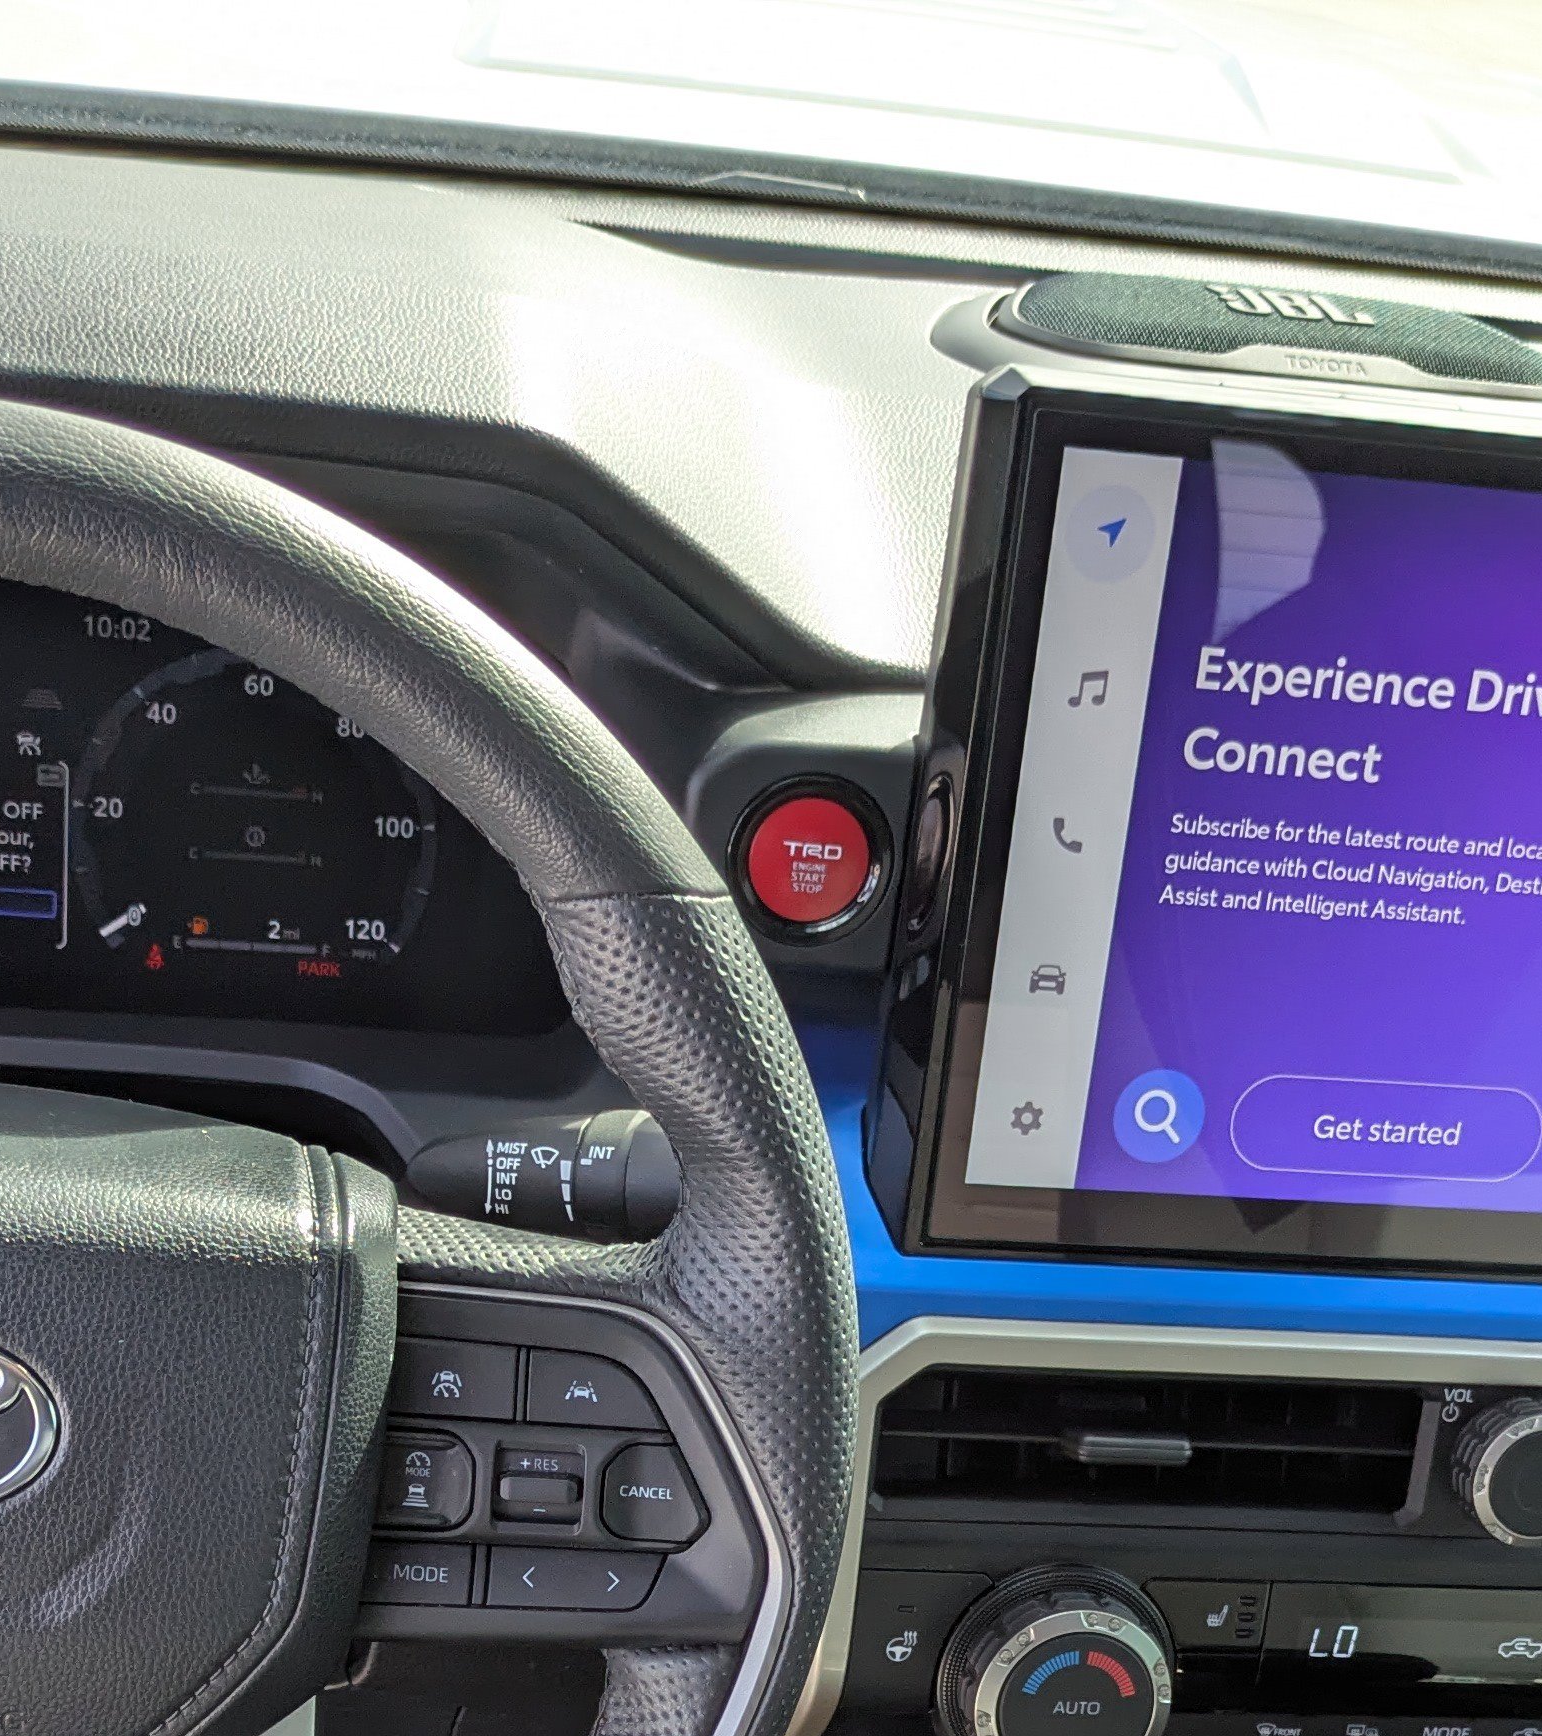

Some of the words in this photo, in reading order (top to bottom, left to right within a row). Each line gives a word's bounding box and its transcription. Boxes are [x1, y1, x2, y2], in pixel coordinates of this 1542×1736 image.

[1209, 284, 1374, 329] JBL
[1284, 353, 1368, 378] TOYOTA
[83, 614, 153, 643] 10:02
[244, 675, 275, 698] 60
[1195, 645, 1456, 711] Experience
[145, 703, 178, 727] 40
[337, 716, 367, 740] 80
[1183, 726, 1383, 784] Connect
[3, 802, 44, 821] OFF
[92, 797, 124, 820] 20
[374, 816, 414, 839] 100
[1170, 814, 1270, 840] Subscribe
[1274, 820, 1304, 844] for
[1306, 824, 1341, 847] the
[1344, 826, 1402, 851] latest
[1405, 834, 1459, 855] route
[1463, 835, 1502, 858] and
[783, 840, 843, 861] TRD
[791, 872, 826, 884] START
[1164, 852, 1260, 881] guidance
[1264, 857, 1308, 880] with
[1312, 860, 1373, 884] Cloud
[1377, 865, 1491, 896] Navigation,
[792, 882, 823, 894] STOP
[1158, 885, 1219, 909] Assist
[1221, 889, 1261, 911] and
[1265, 893, 1369, 920] Intelligent
[1370, 901, 1467, 927] Assistant.
[268, 920, 281, 940] 2
[345, 918, 385, 941] 120
[297, 960, 341, 977] PARK
[1312, 1114, 1363, 1143] Get
[1367, 1118, 1463, 1147] started
[495, 1142, 528, 1154] MIST
[588, 1145, 615, 1160] INT
[495, 1157, 521, 1170] OFF
[495, 1172, 518, 1185] INT
[495, 1188, 512, 1201] LO
[495, 1203, 510, 1215] HI
[1444, 1388, 1473, 1403] VOL
[405, 1467, 431, 1478] MODE
[619, 1485, 674, 1501] CANCEL
[393, 1564, 449, 1584] MODE
[1308, 1625, 1359, 1659] LO
[1052, 1700, 1101, 1717] AUTO
